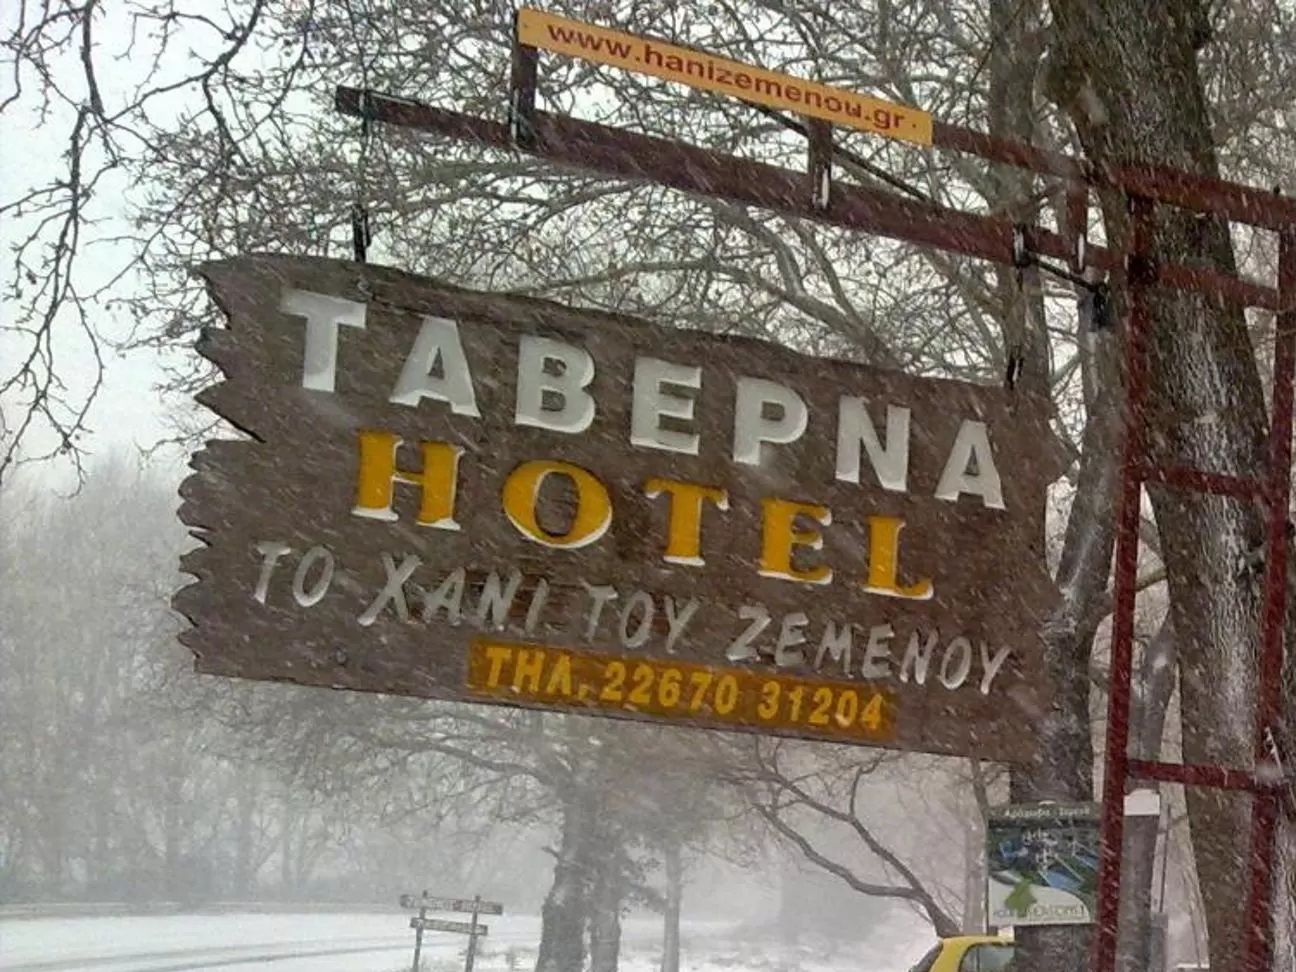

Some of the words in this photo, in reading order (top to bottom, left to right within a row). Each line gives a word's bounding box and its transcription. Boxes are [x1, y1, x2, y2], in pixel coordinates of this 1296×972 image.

[546, 19, 906, 131] www.hanizemenou.gr
[281, 288, 1006, 510] ΤΑΒΕΡΝΑ
[351, 429, 934, 601] HOTEL
[253, 540, 335, 608] ΤΟ
[579, 584, 700, 654] ΤΟΥ
[725, 605, 1012, 697] ΖΕΜΕΝΟΥ
[757, 680, 885, 731] 31204
